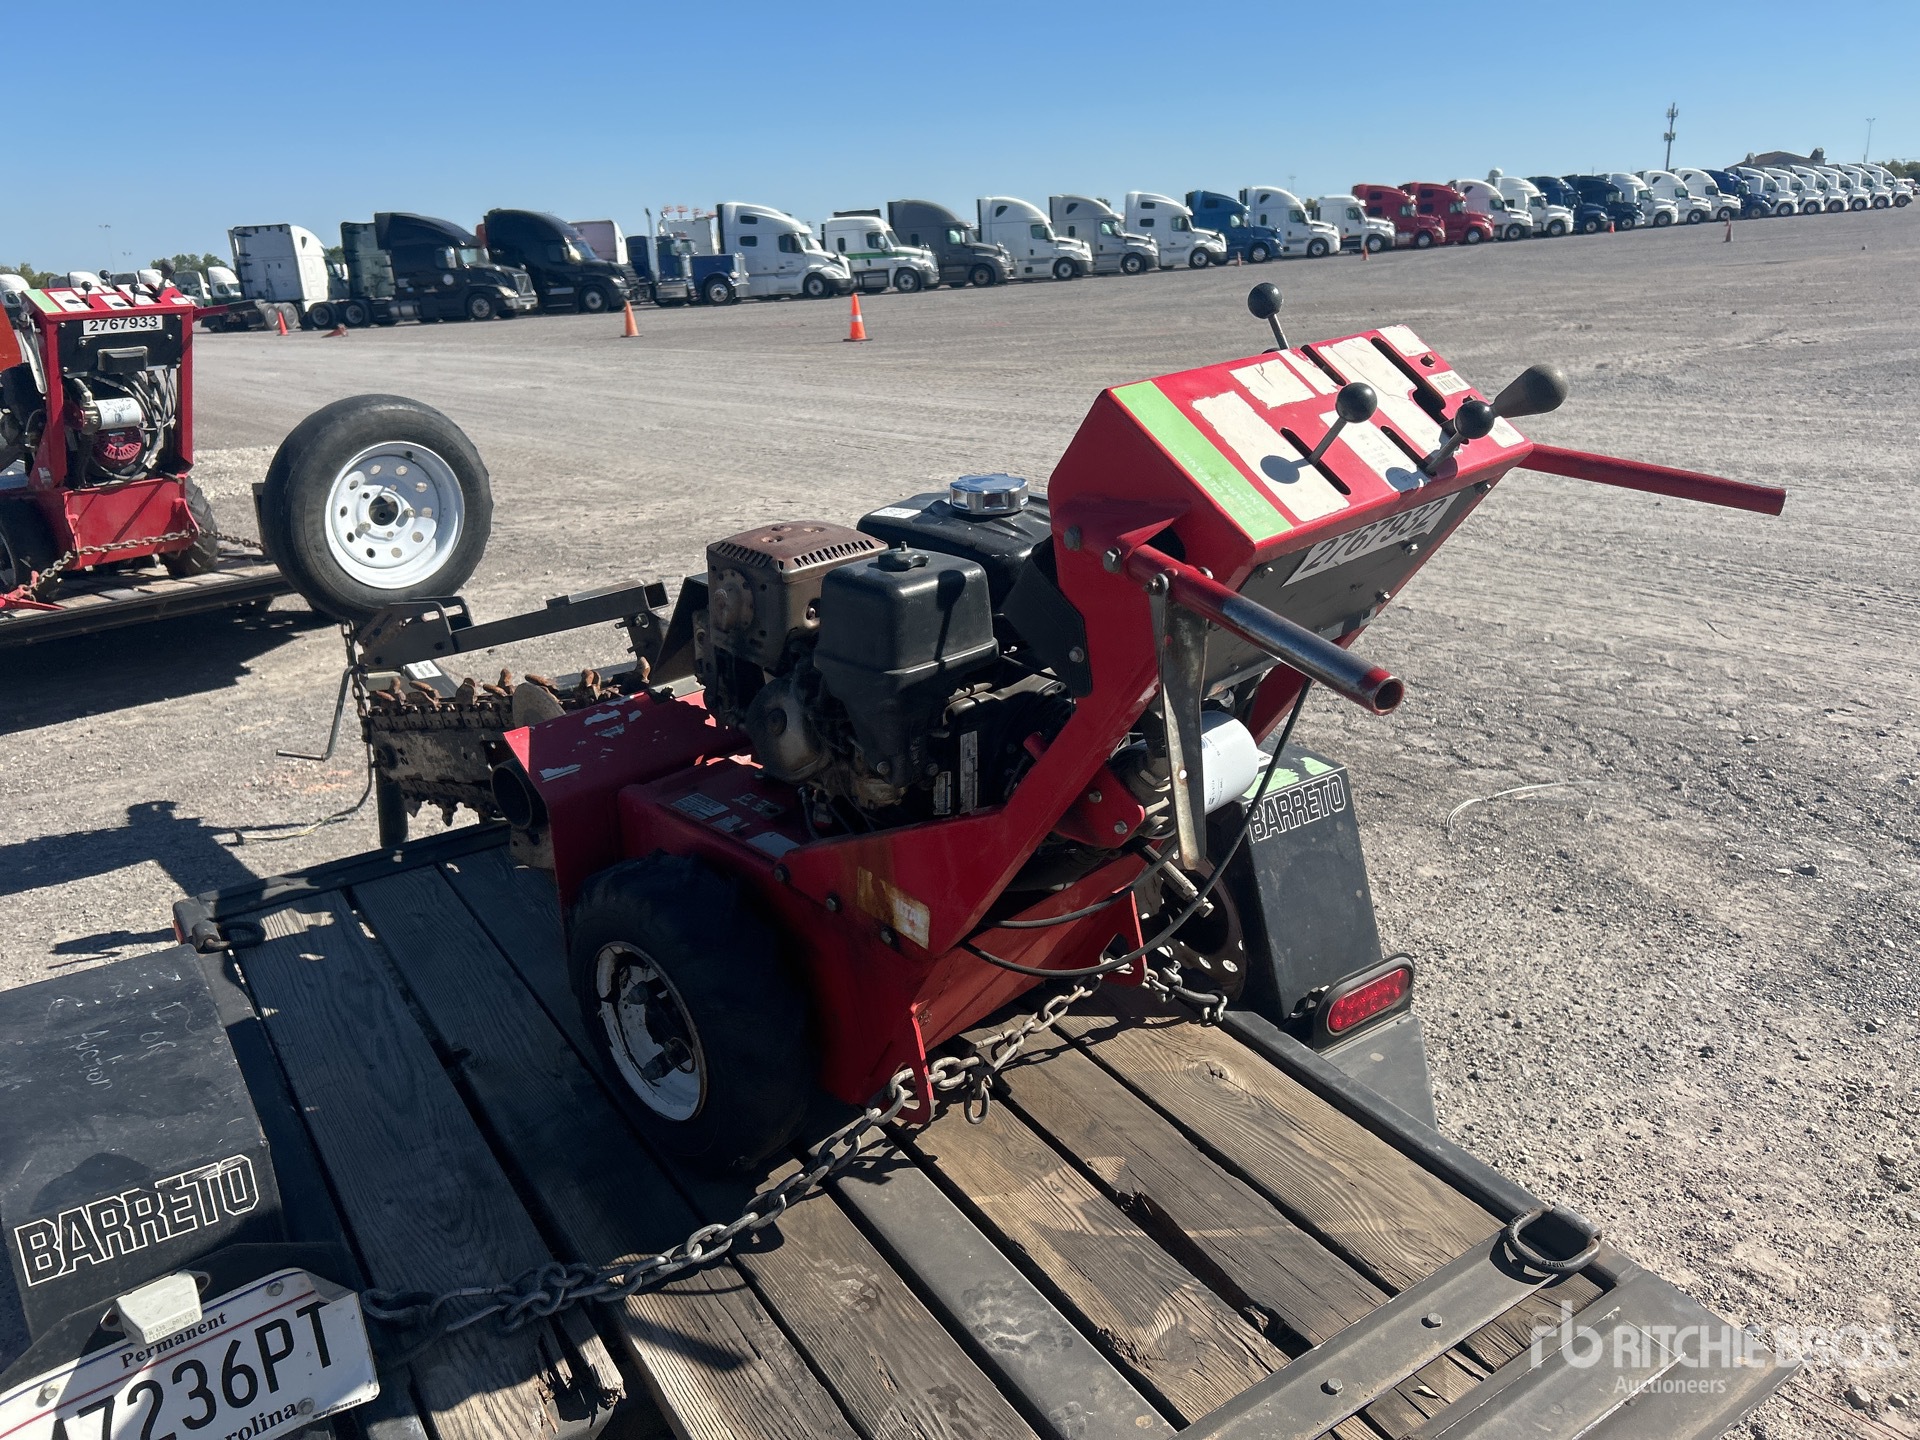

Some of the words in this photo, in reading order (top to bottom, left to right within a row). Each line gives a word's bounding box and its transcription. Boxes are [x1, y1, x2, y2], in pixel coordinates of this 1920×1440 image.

[89, 316, 158, 331] 2767933
[1299, 498, 1448, 573] 2767932
[1246, 774, 1346, 843] BARRETO
[14, 1154, 260, 1287] BARRETO
[51, 1301, 332, 1440] 7236PT
[121, 1310, 228, 1369] Permanent
